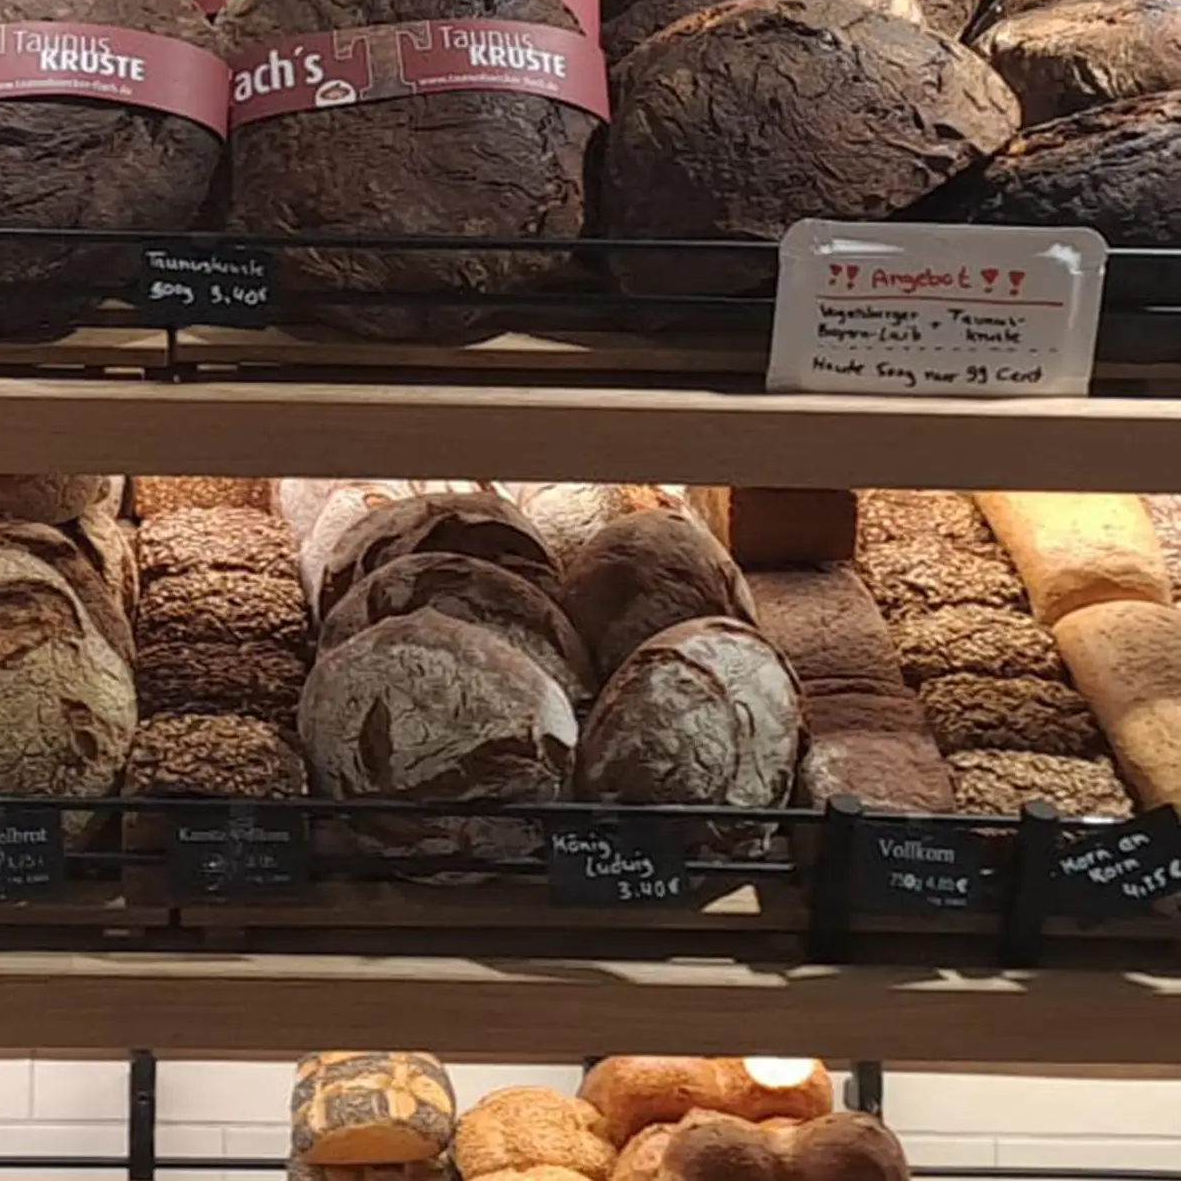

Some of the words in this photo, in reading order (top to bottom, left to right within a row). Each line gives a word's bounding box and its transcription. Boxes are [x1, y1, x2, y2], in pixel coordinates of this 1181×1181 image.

[13, 29, 113, 55] Taunus
[438, 25, 534, 51] Taunus
[40, 48, 147, 82] KRUSTE
[232, 46, 324, 102] ach's
[470, 43, 567, 78] KRUSTE
[872, 266, 971, 294] Angebot
[552, 832, 611, 860] König
[586, 851, 655, 878] Ludwig
